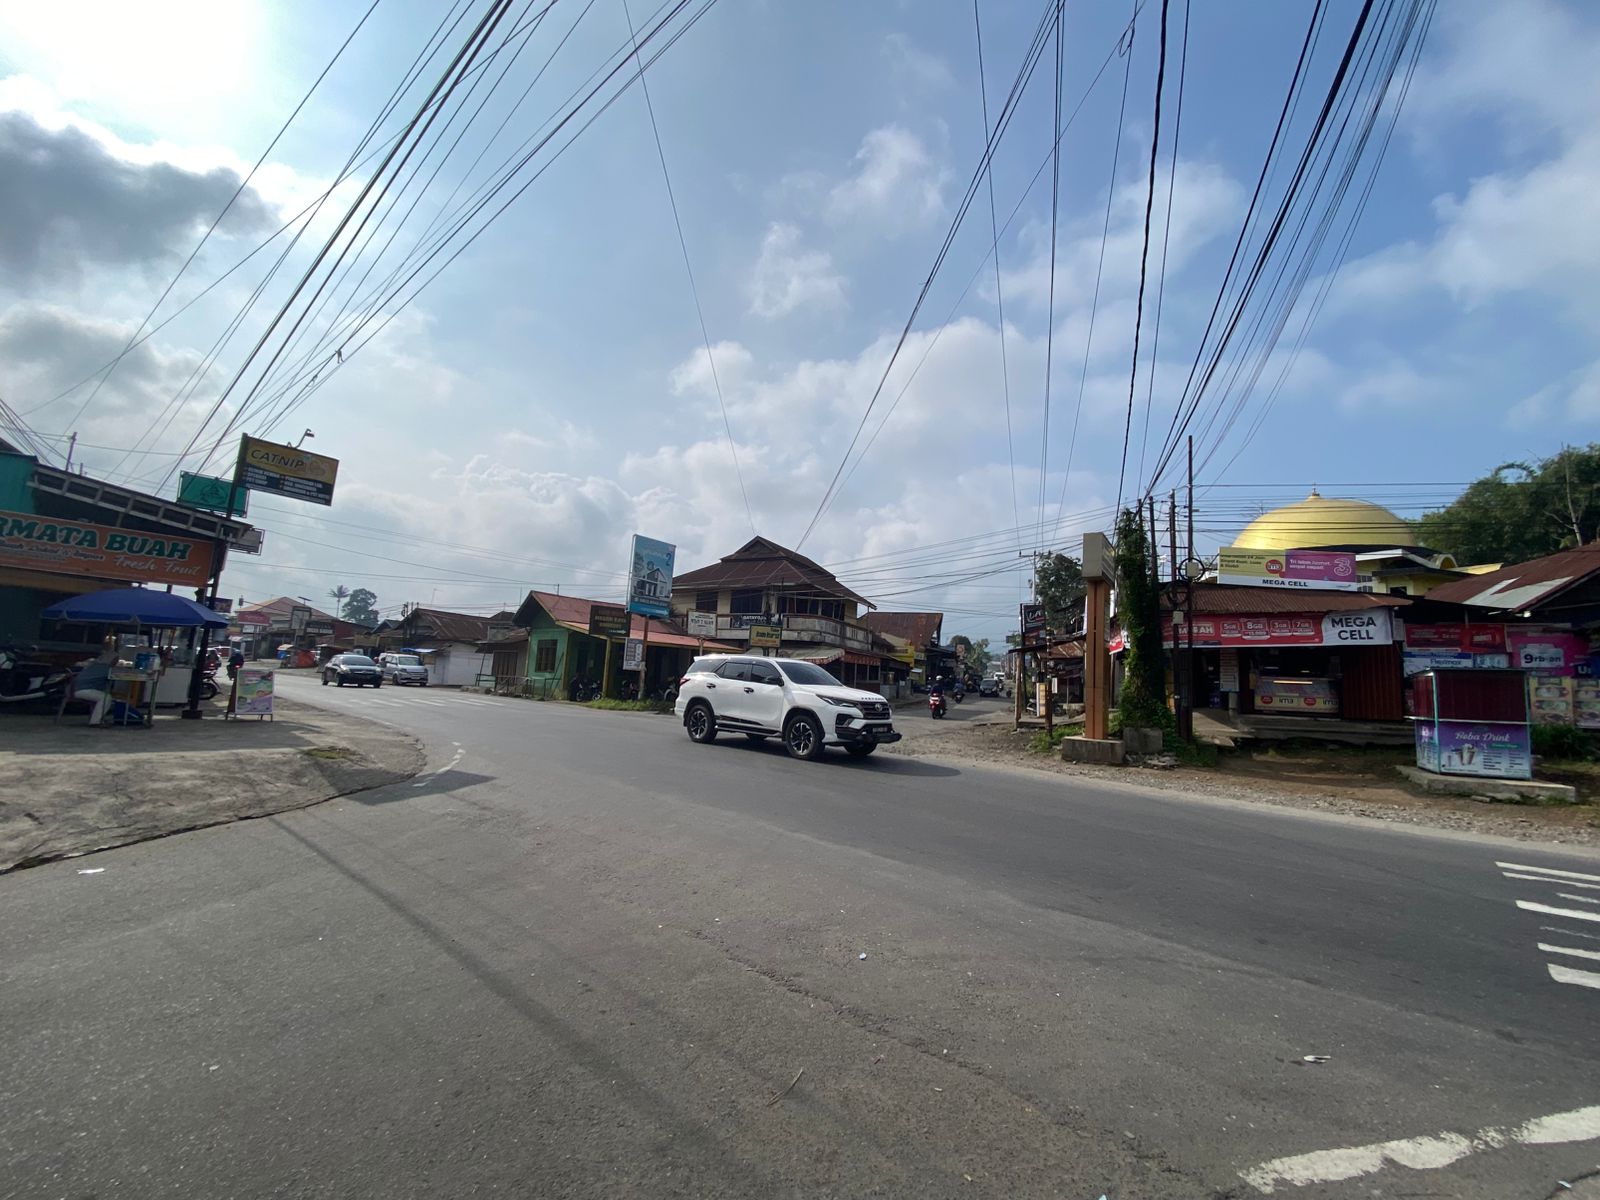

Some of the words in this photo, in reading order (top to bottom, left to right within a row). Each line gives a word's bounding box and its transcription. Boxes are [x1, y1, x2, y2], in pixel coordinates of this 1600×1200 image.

[251, 449, 305, 469] CATNIP
[105, 533, 192, 559] BUAH
[114, 556, 156, 570] Fresh
[162, 561, 200, 575] Fruit
[1331, 617, 1376, 628] MEGA
[1338, 630, 1374, 640] CELL
[1481, 732, 1510, 742] Drink
